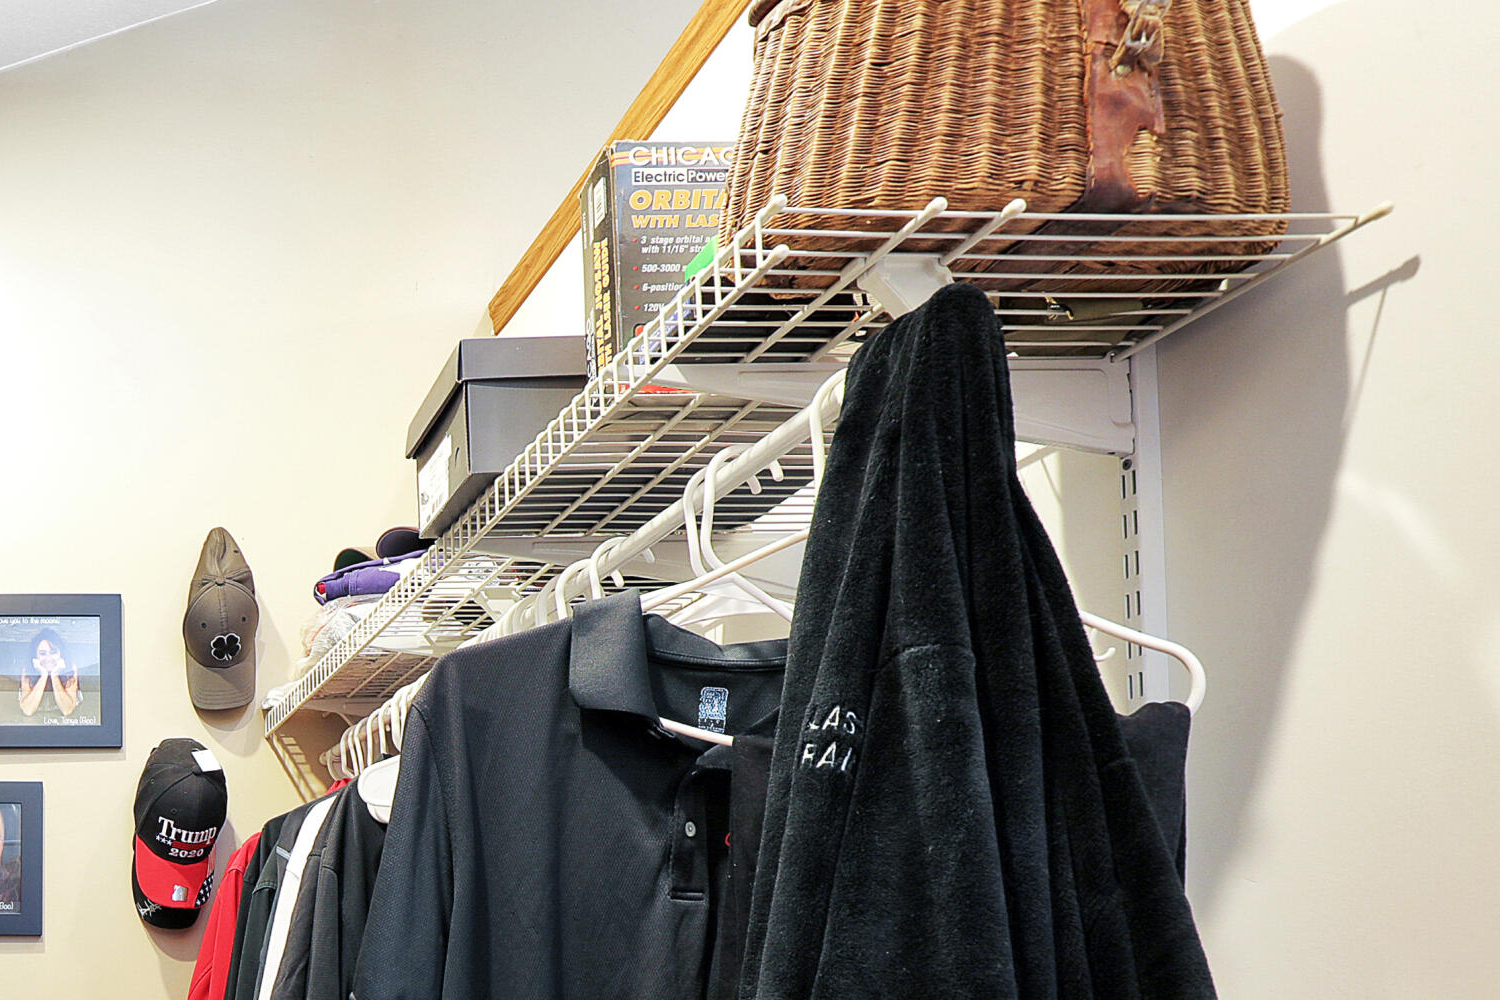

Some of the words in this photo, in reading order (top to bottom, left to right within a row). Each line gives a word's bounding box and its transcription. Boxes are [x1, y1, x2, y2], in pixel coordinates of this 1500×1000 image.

[633, 170, 685, 183] Electric
[631, 214, 679, 228] WITH
[640, 235, 647, 244] 3
[650, 236, 674, 246] stage
[675, 234, 703, 244] orbital
[641, 244, 659, 254] with
[641, 263, 680, 273] 500-3000
[158, 816, 217, 845] Trump
[168, 847, 204, 858] 2020
